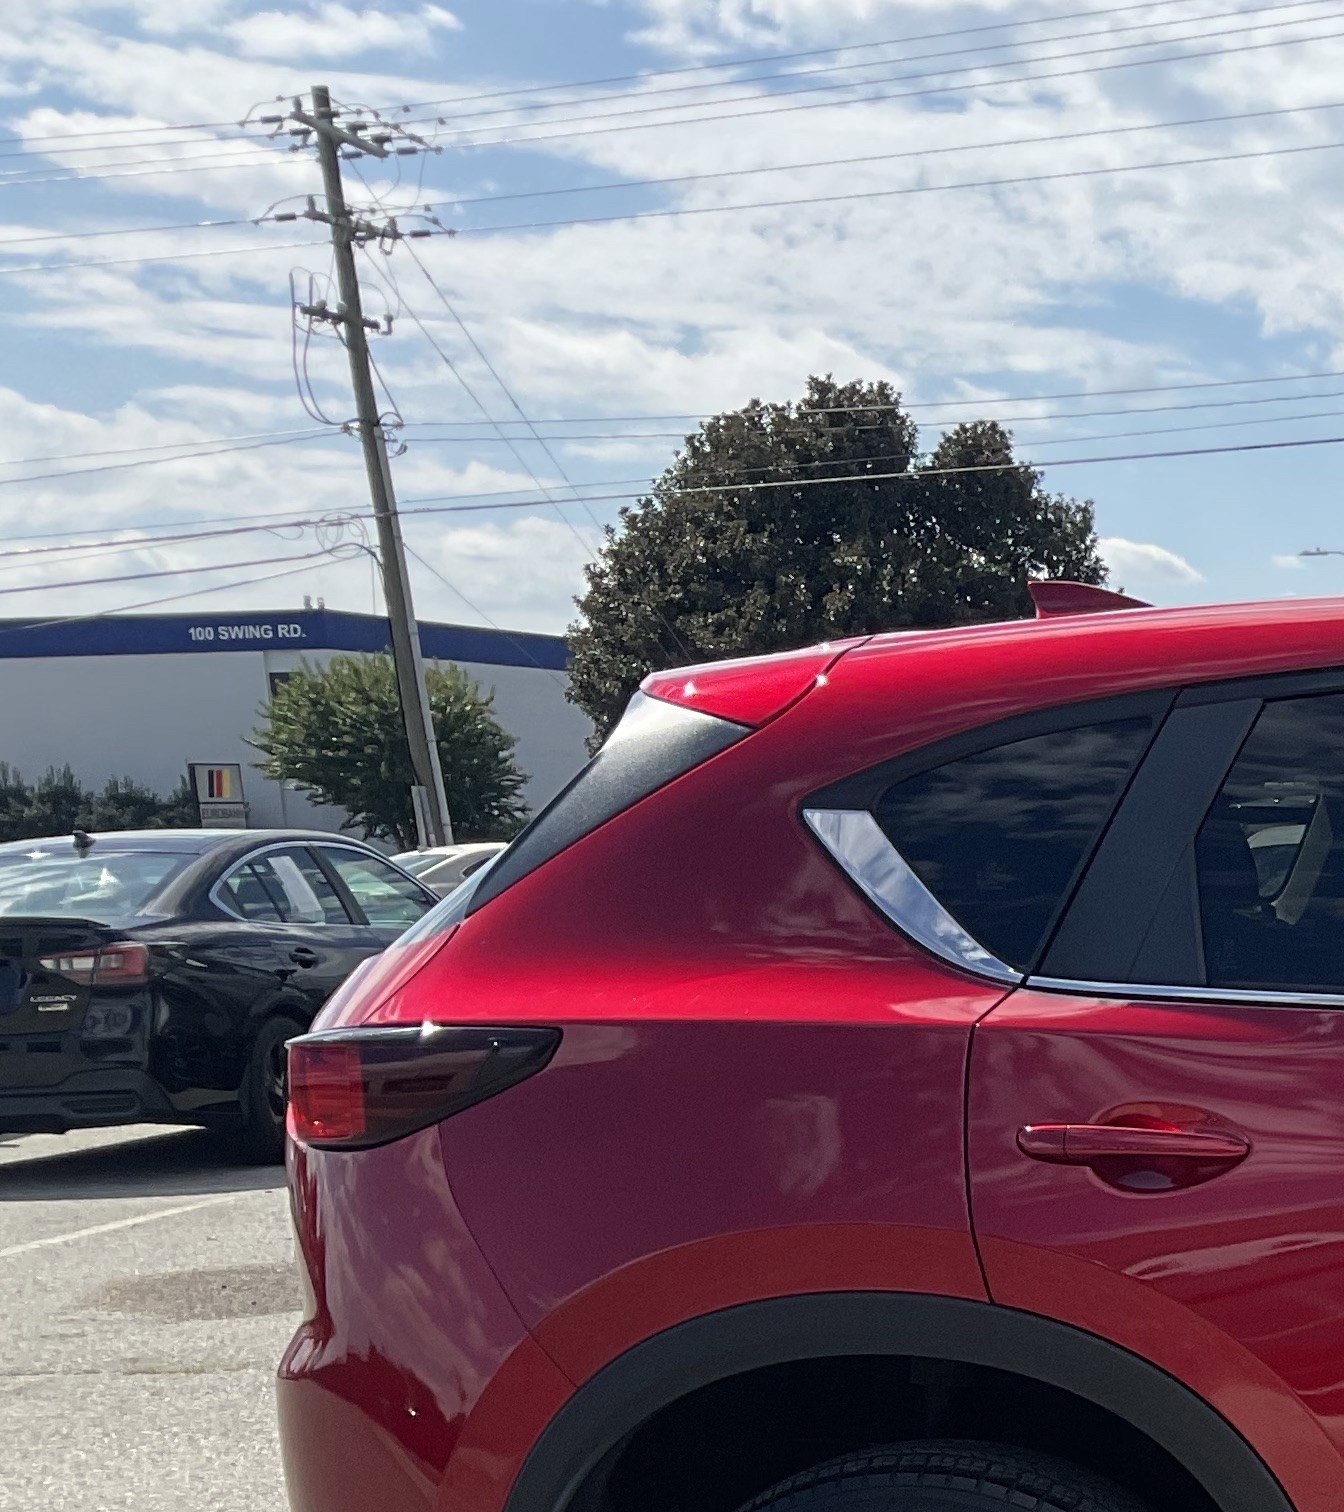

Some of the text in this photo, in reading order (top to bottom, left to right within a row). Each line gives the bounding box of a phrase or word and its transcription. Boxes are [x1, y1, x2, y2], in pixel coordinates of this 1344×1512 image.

[188, 623, 307, 641] 100 SWING RD.
